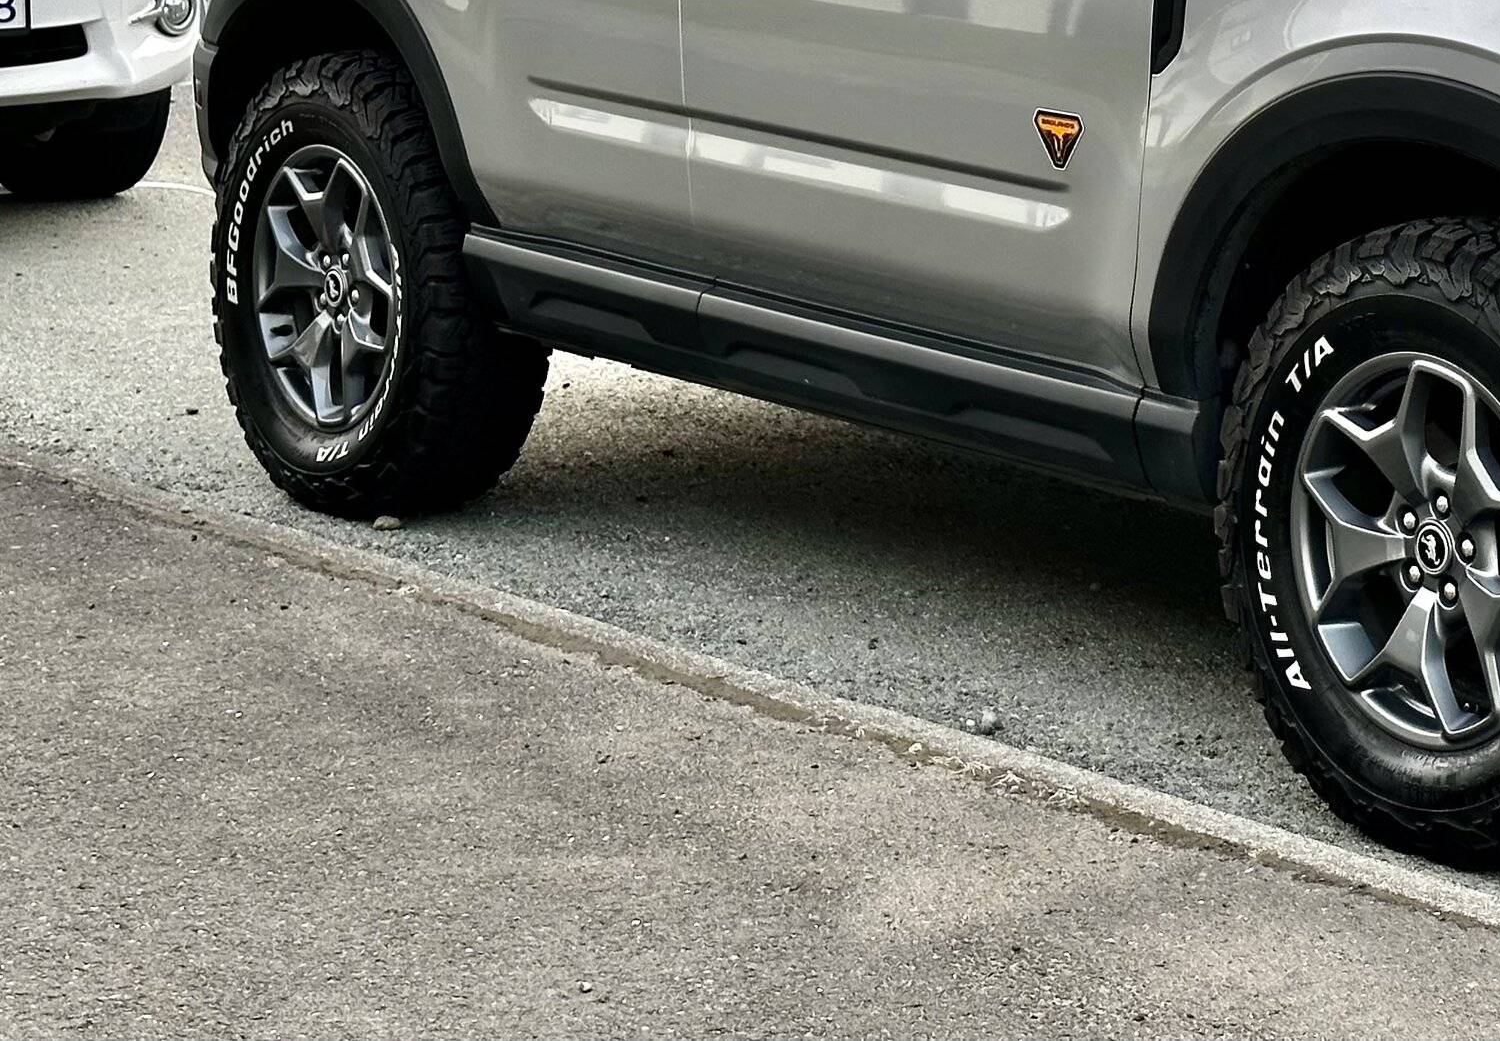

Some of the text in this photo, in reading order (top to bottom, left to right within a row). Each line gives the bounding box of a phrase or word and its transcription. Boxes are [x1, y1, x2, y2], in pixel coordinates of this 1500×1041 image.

[226, 118, 294, 305] BFGoodrich
[1254, 335, 1334, 691] All-Terrain T/A
